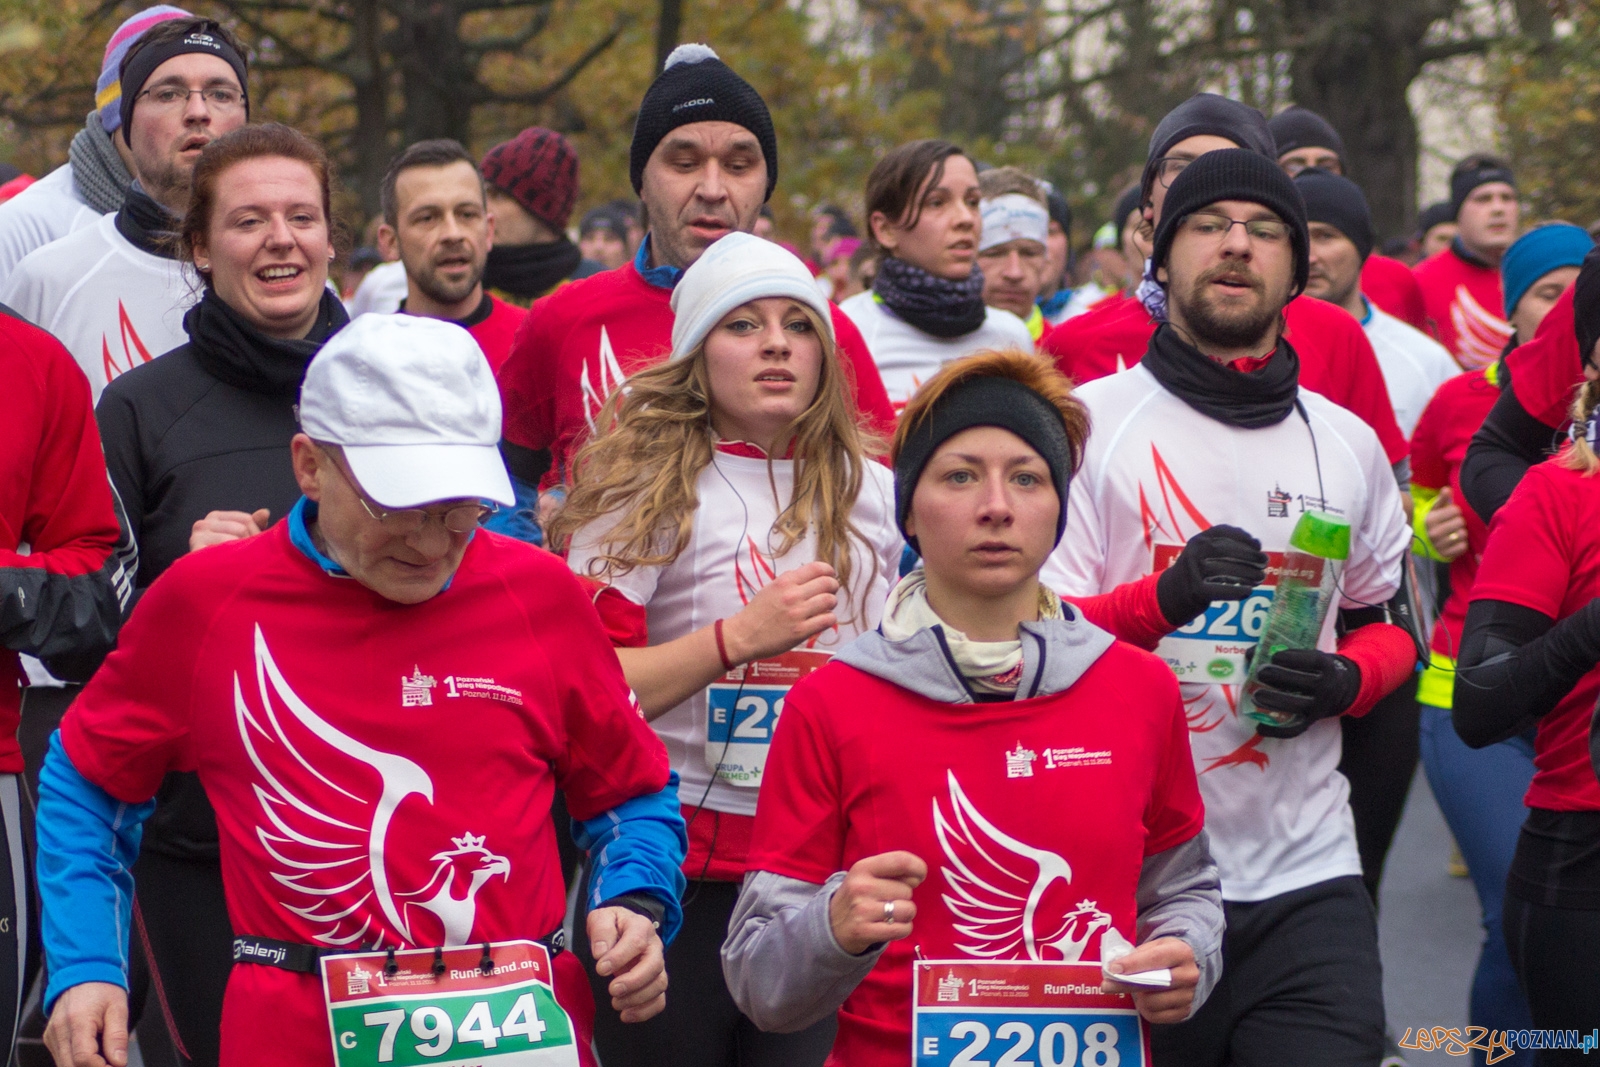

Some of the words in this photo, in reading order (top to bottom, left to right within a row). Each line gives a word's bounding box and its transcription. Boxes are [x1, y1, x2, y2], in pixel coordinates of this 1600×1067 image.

[1297, 494, 1305, 513] 1
[751, 662, 760, 677] 1
[443, 676, 460, 698] 1
[713, 708, 727, 724] E
[1042, 748, 1057, 769] 1
[716, 772, 750, 781] UXMED
[375, 970, 388, 987] 1
[968, 978, 979, 998] 1
[340, 1031, 357, 1049] C
[363, 992, 547, 1063] 7944
[923, 1037, 939, 1056] E
[949, 1020, 1120, 1067] 2208
